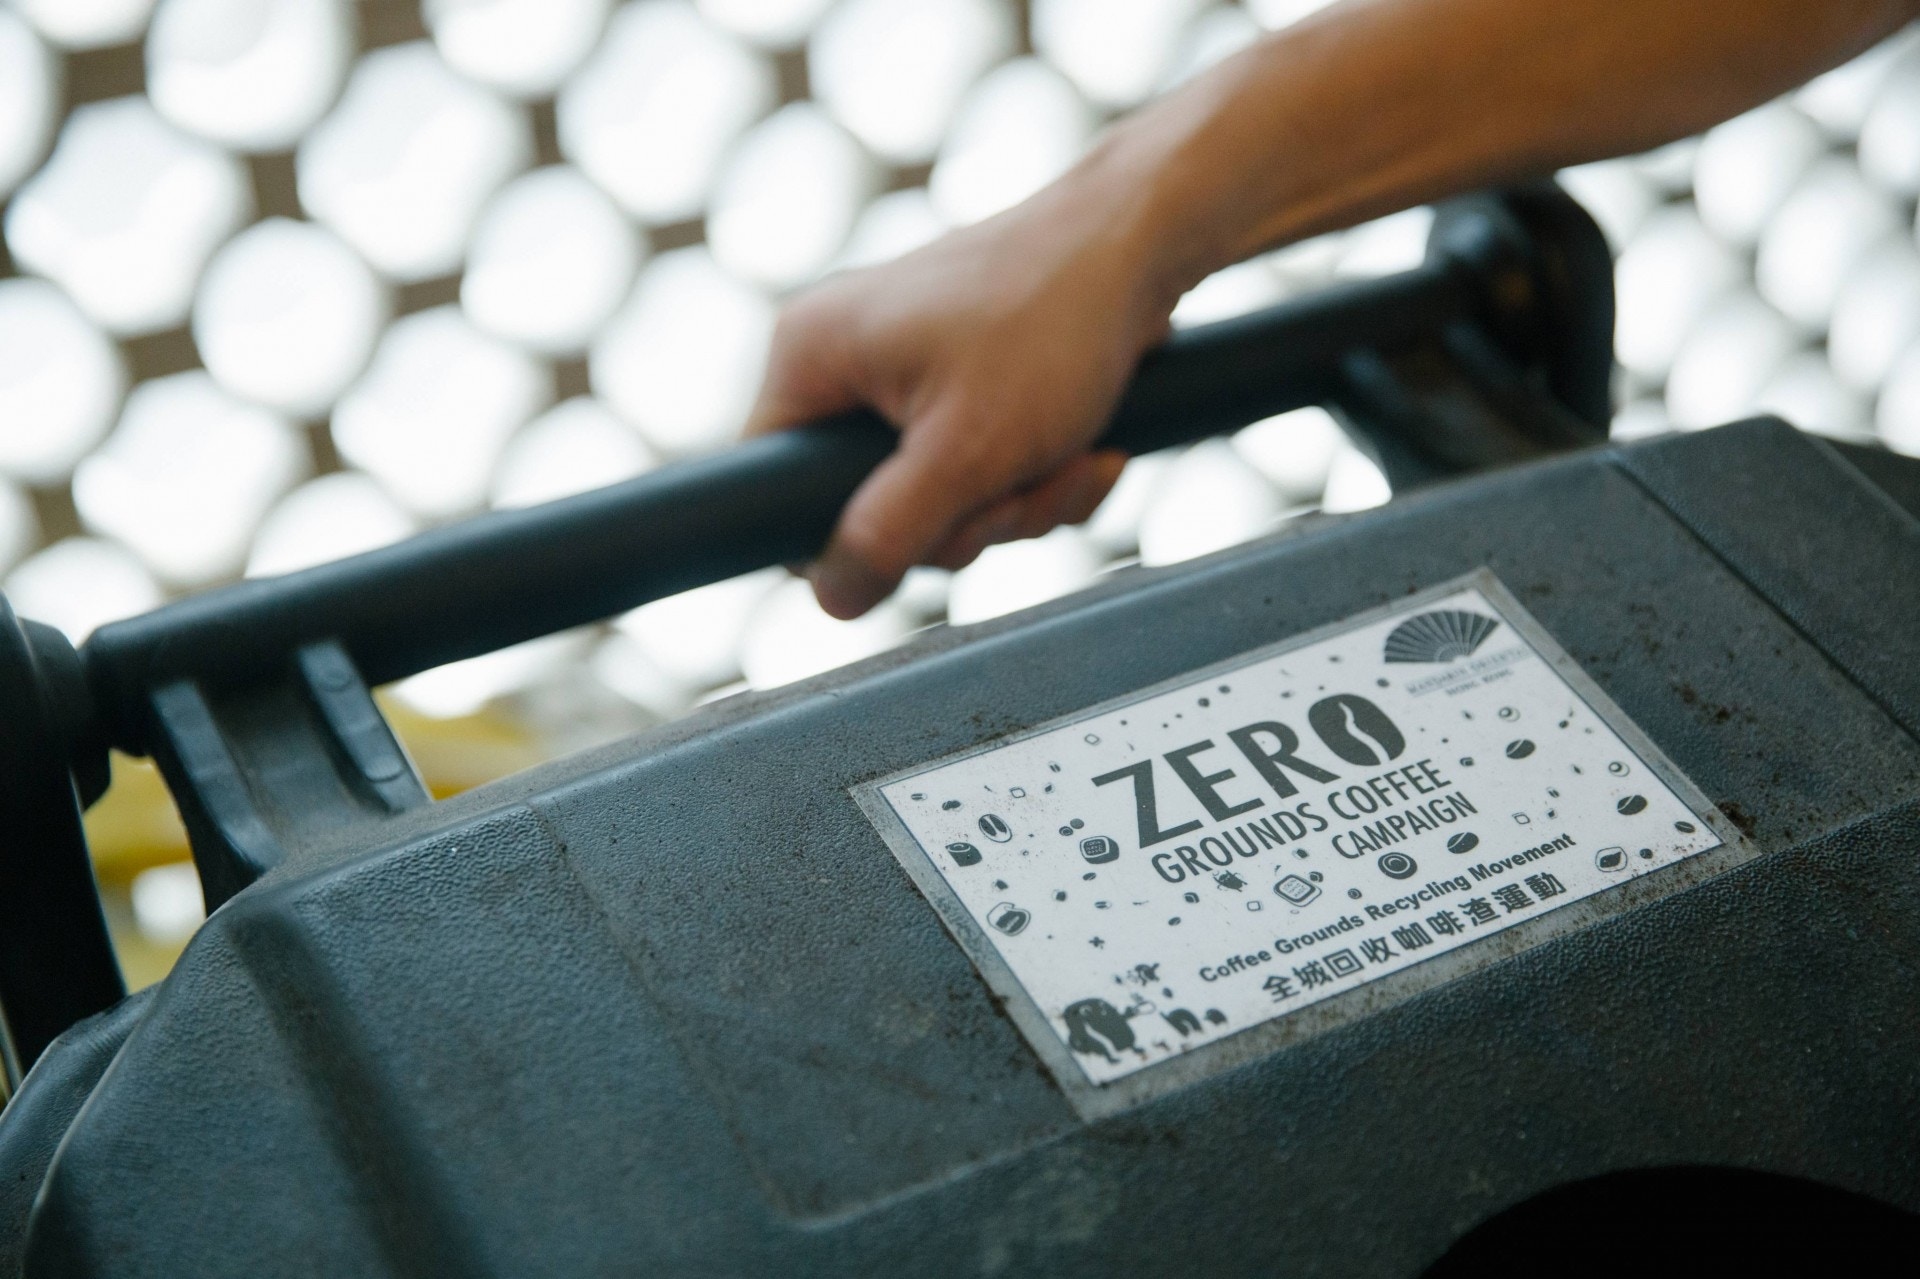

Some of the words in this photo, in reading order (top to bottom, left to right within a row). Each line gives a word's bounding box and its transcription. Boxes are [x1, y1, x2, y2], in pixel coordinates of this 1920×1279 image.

[1091, 694, 1405, 848] ZERO
[1152, 803, 1328, 883] GROUNDS
[1328, 759, 1451, 820] COFFEE
[1332, 792, 1477, 859] CAMPAIGN
[1200, 951, 1271, 981] Coffee
[1275, 916, 1364, 954] Grounds
[1364, 876, 1472, 920] Recycling
[1468, 834, 1576, 881] Movement
[1263, 872, 1566, 1002] 全城回收咖啡渣運動
